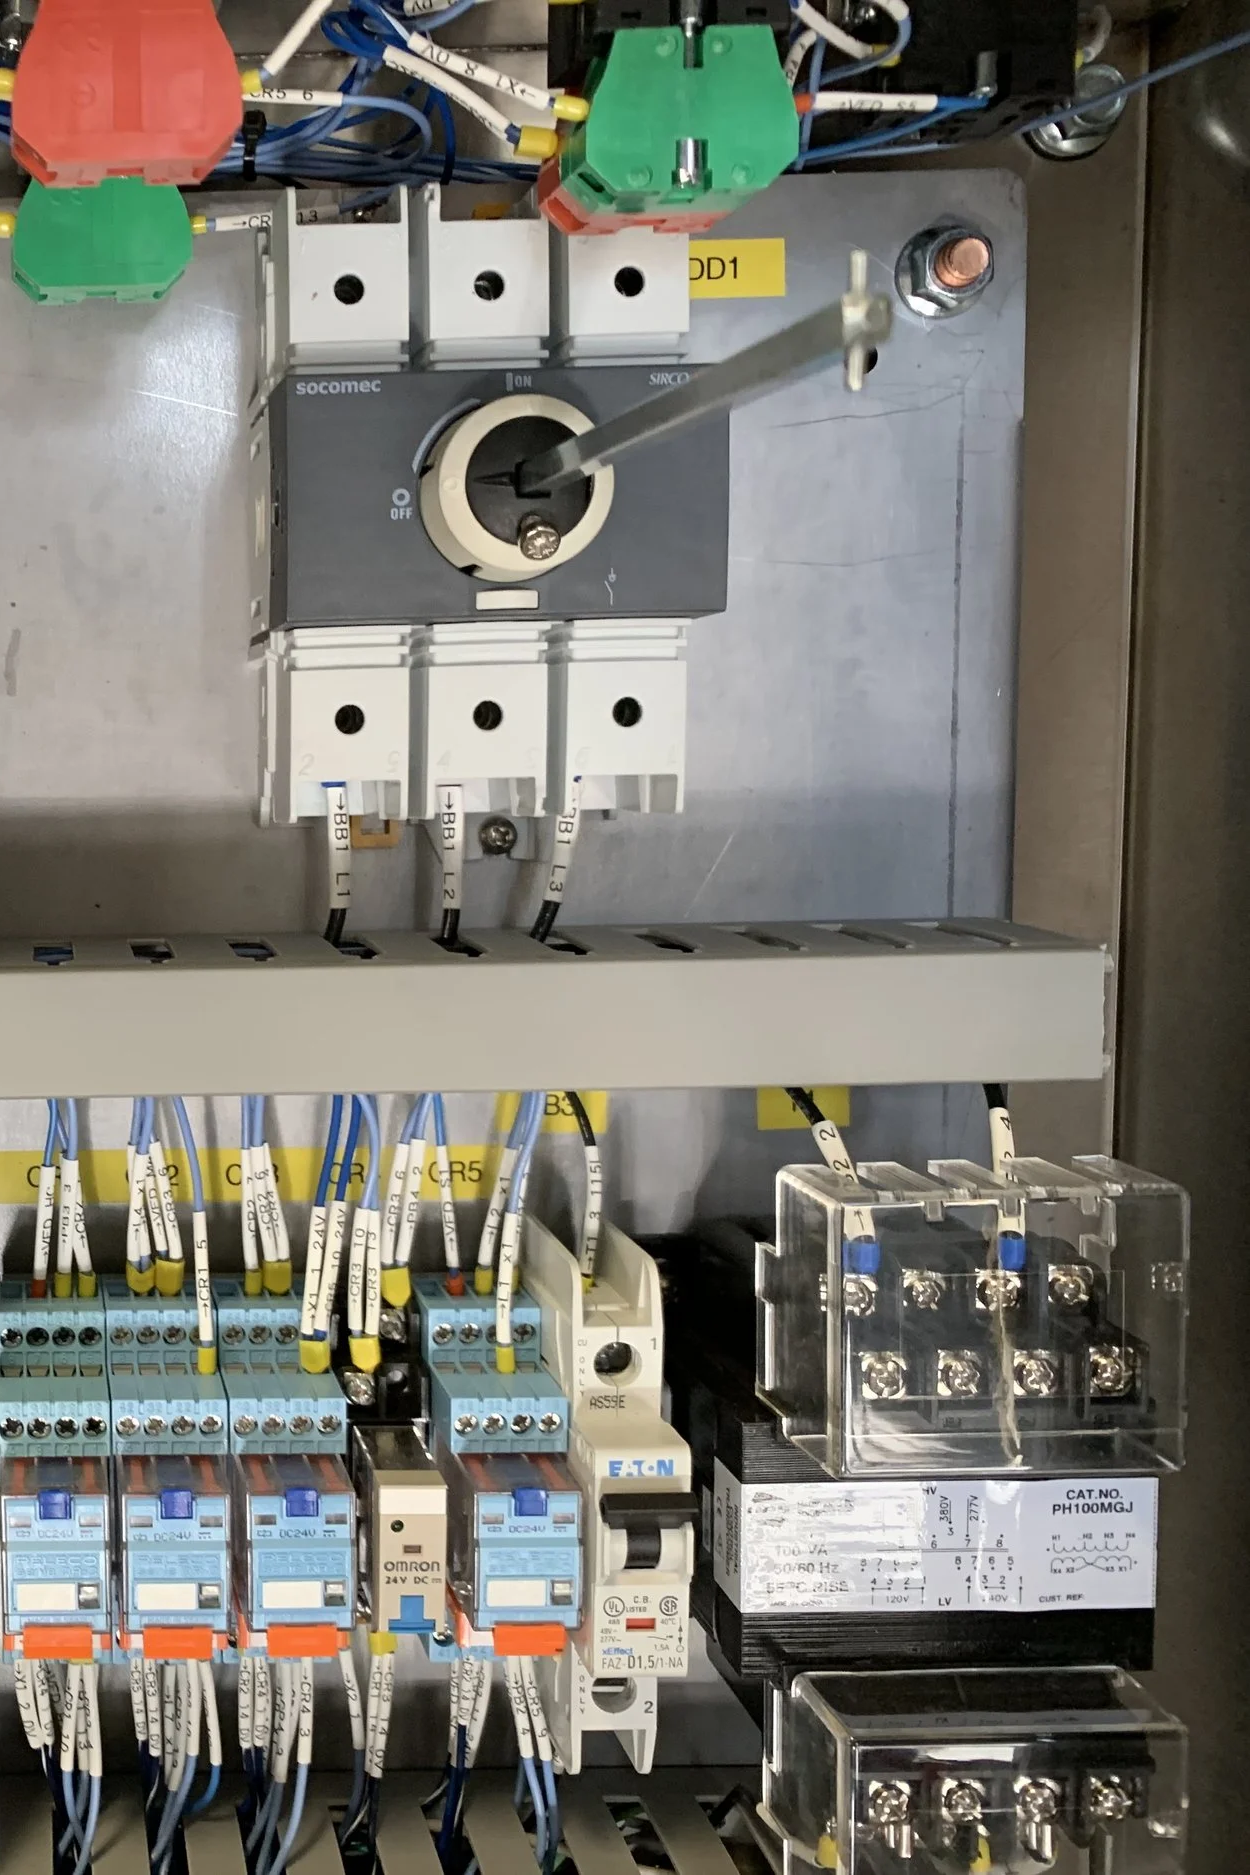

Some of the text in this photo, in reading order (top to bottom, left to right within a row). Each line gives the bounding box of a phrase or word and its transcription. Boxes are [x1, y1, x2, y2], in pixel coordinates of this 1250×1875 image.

[421, 42, 450, 64] 0V
[296, 379, 381, 395] socomec
[514, 374, 532, 388] ON
[390, 507, 413, 520] OFF
[334, 813, 350, 896] BB1 L1
[442, 813, 456, 900] BB1 L2
[549, 865, 566, 892] L3
[1000, 1116, 1011, 1130] 4
[820, 1126, 837, 1141] 2
[387, 1170, 405, 1228] CR3 6
[407, 1166, 423, 1223] PB4 2
[439, 1169, 455, 1236] VFD S1
[332, 1212, 346, 1269] 10 24V
[586, 1237, 598, 1254] T1
[502, 1244, 512, 1262] x1
[198, 1239, 209, 1301] CR1 5
[307, 1214, 326, 1312] X1 24V
[350, 1228, 365, 1297] CR3 10
[368, 1266, 378, 1302] CR3
[650, 1337, 657, 1350] 1
[1066, 1489, 1123, 1500] CAT.NO.
[939, 1496, 949, 1522] 380V
[969, 1495, 979, 1522] 277V
[1052, 1501, 1134, 1515] PH100MGJ
[280, 1529, 316, 1538] DC24V
[509, 1525, 546, 1533] DC24V
[154, 1532, 191, 1542] DC24V
[931, 1540, 937, 1549] 6
[965, 1539, 971, 1548] 7
[997, 1539, 1003, 1548] 8
[383, 1561, 440, 1572] OMRON
[819, 1562, 840, 1574] Hz
[955, 1556, 1013, 1565] 8 6 5
[966, 1575, 1005, 1584] 4 2
[886, 1595, 909, 1604] 120V
[939, 1597, 952, 1606] LV
[1039, 1594, 1061, 1602] CUST
[602, 1655, 683, 1670] FAZ-D1,5/1-NA
[146, 1673, 157, 1697] CR3
[513, 1686, 527, 1714] PB2
[527, 1686, 542, 1717] CR5
[644, 1701, 654, 1714] 2
[300, 1682, 312, 1737] CR4 3
[374, 1749, 386, 1770] 0V
